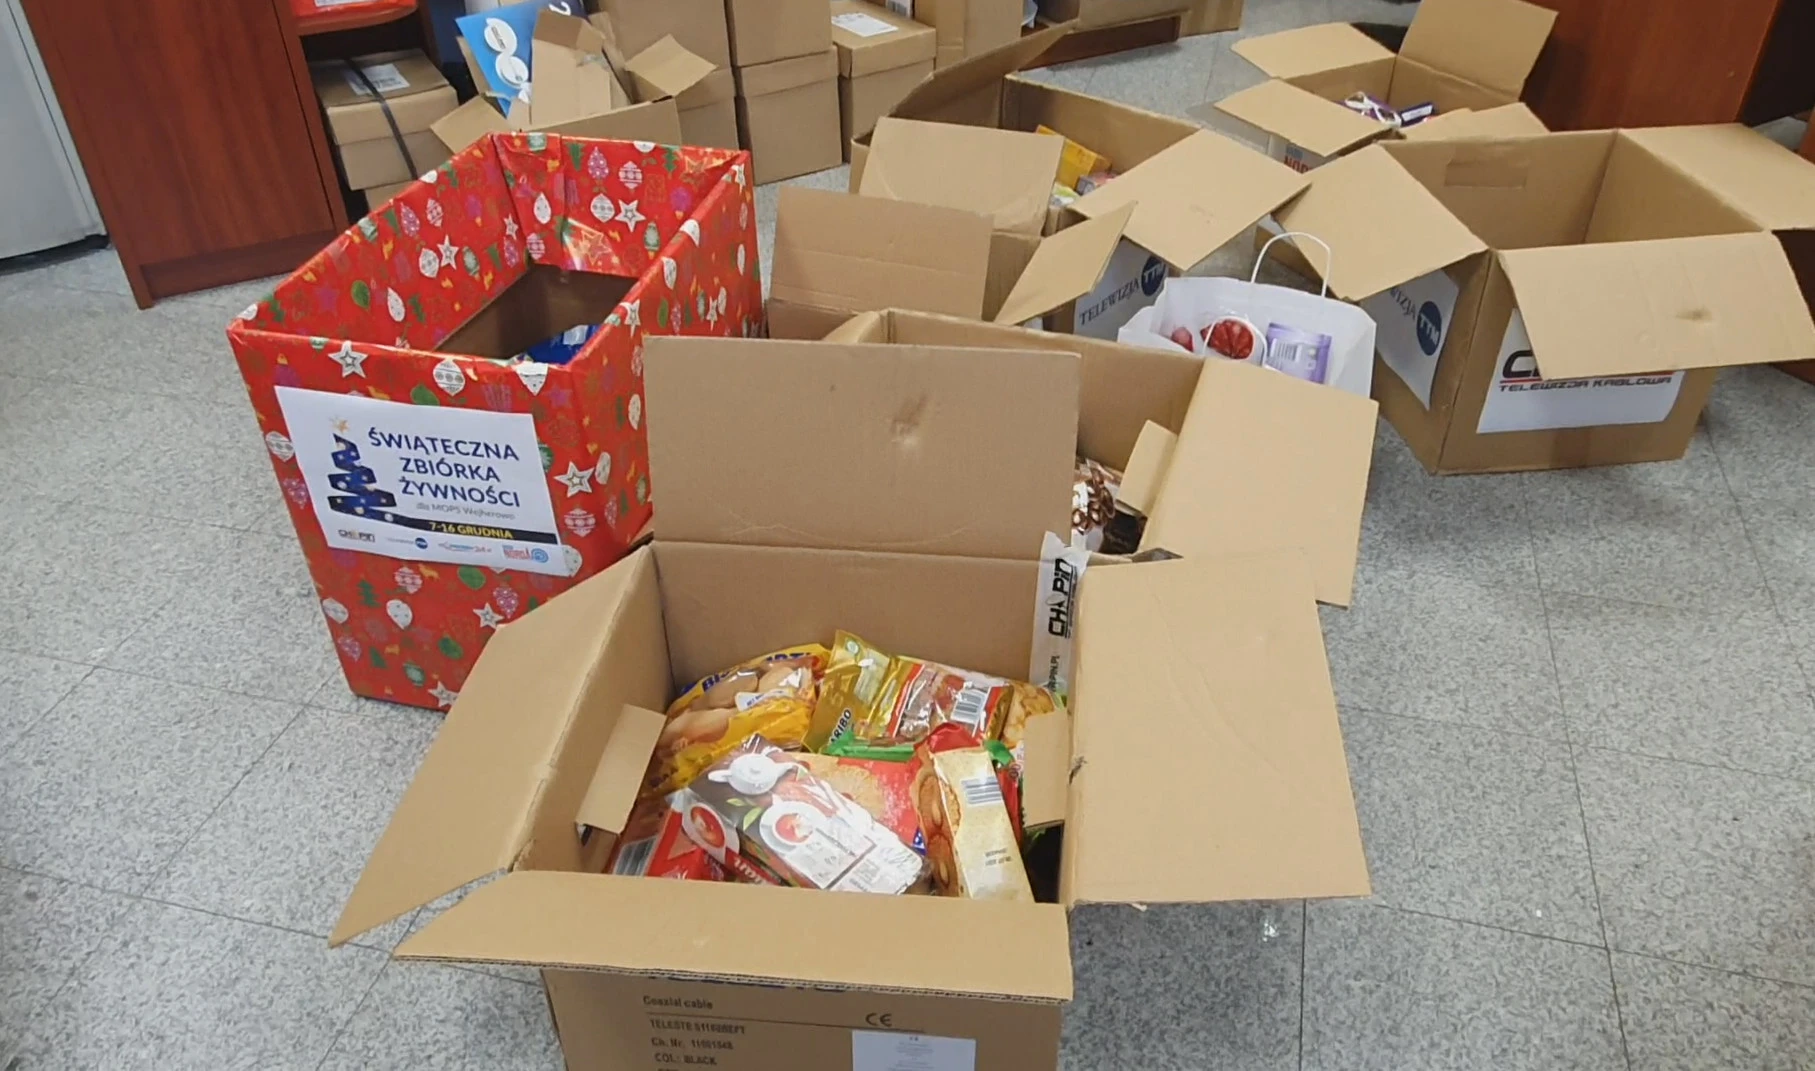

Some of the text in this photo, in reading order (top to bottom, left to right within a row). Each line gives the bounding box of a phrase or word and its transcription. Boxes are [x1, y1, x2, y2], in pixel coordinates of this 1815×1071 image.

[1079, 278, 1140, 325] TELEWIZJA
[1420, 312, 1440, 346] TTM
[1499, 376, 1672, 392] TELEWIZJA KABLOWA
[368, 427, 520, 461] ŚWIĄTECZNA
[400, 457, 501, 483] ZBIÓRKA
[399, 476, 520, 508] ŻYWNOŚCI
[432, 504, 461, 515] MOPS
[463, 508, 516, 520] Wejherowo
[429, 521, 514, 539] 7-16 GRUDNIA
[642, 995, 713, 1010] Coaxial cable
[684, 1055, 718, 1066] BLACK
